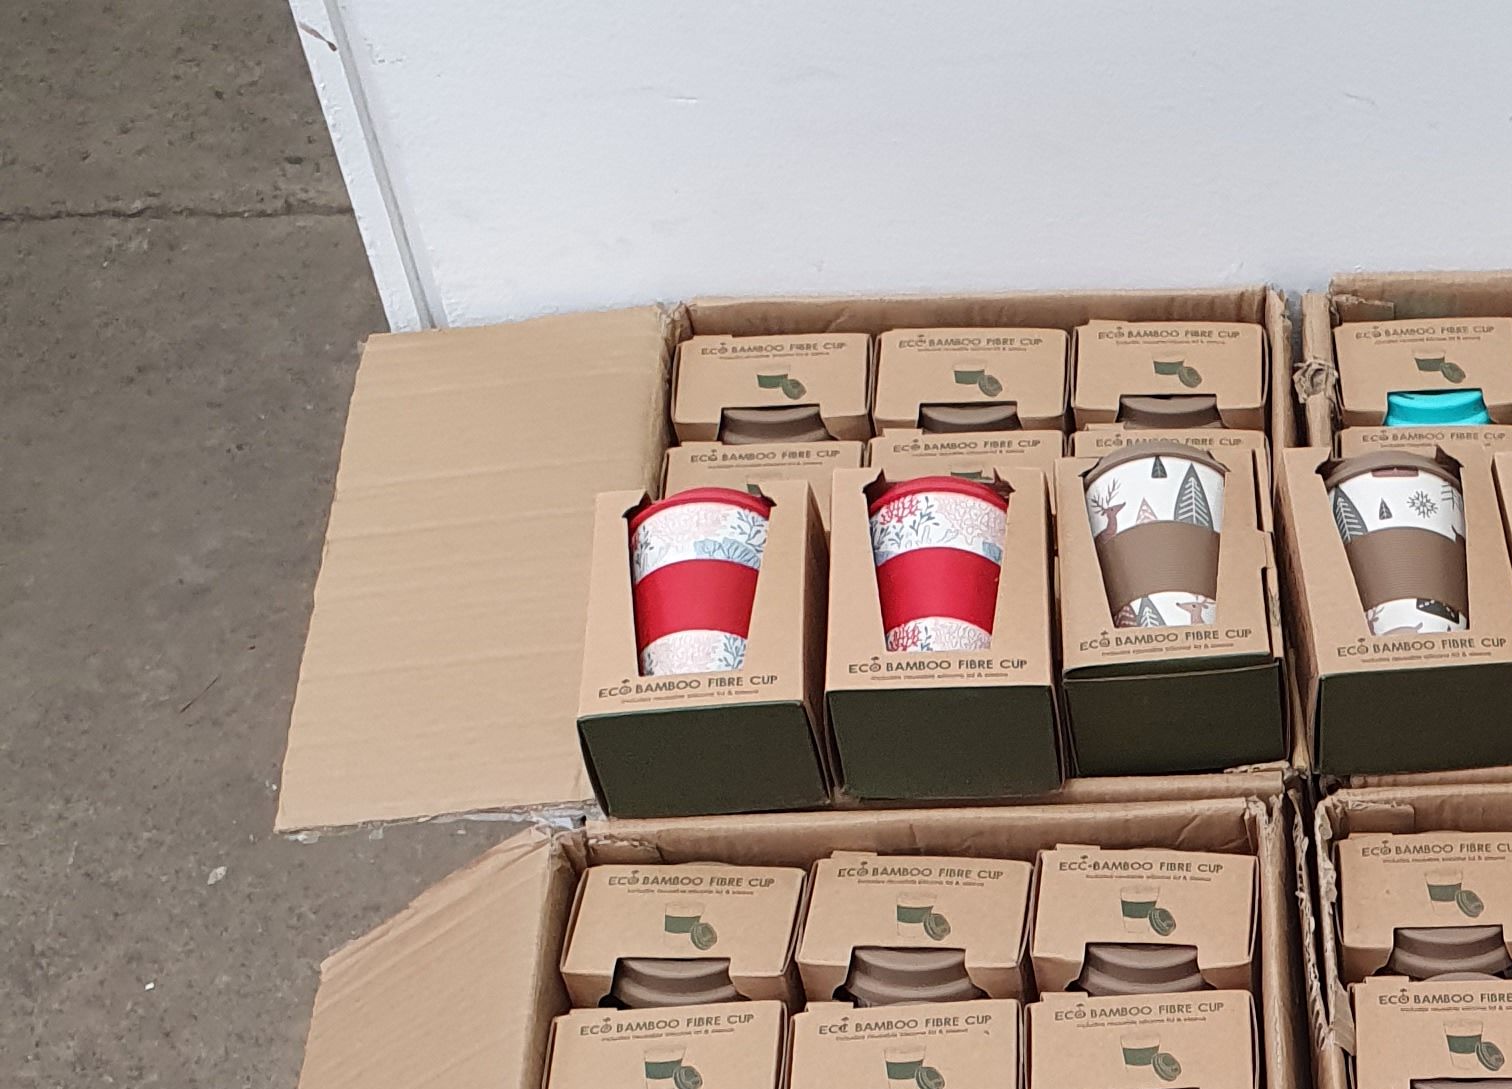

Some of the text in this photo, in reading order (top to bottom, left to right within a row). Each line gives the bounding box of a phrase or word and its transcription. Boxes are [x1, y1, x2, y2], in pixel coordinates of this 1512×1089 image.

[1126, 329, 1181, 339] BAMBOO
[1183, 329, 1214, 339] FIBRE
[1216, 329, 1241, 339] CUP
[1078, 634, 1111, 652] ECO
[1113, 631, 1179, 647] BAMBOO
[1183, 629, 1220, 642] FIBRE
[1223, 627, 1253, 640] CUP
[1335, 641, 1370, 658] ECO
[1371, 639, 1436, 654] BAMBOO
[1440, 636, 1476, 650] FIBRE
[1479, 636, 1507, 648] CUP
[847, 657, 1028, 675] ECO BAMBOO FIBRE CUP
[597, 682, 633, 699] ECO
[634, 678, 702, 695] BAMBOO
[706, 675, 744, 689] FIBRE
[748, 673, 779, 686] CUP
[1360, 842, 1393, 858] ECO
[1393, 842, 1455, 856] BAMBOO
[1458, 841, 1492, 854] FIBRE
[836, 864, 1005, 881] ECO BAMBOO FIBRE CUP
[1090, 859, 1154, 872] BAMBOO
[1158, 860, 1193, 873] FIBRE
[1196, 862, 1224, 874] CUP
[607, 873, 776, 888] ECO BAMBOO FIBRE CUP
[1377, 991, 1411, 1006] ECO
[1412, 992, 1475, 1005] BAMBOO
[1053, 1006, 1087, 1022] ECO
[1089, 1004, 1153, 1019] BAMBOO
[1157, 1002, 1193, 1016] FIBRE
[1196, 1001, 1225, 1013] CUP
[578, 1020, 613, 1037] ECO
[615, 1018, 681, 1034] BAMBOO
[685, 1014, 722, 1029] FIBRE
[725, 1012, 755, 1025] CUP
[853, 1018, 919, 1033] BAMBOO
[923, 1015, 960, 1029] FIBRE
[963, 1013, 993, 1026] CUP
